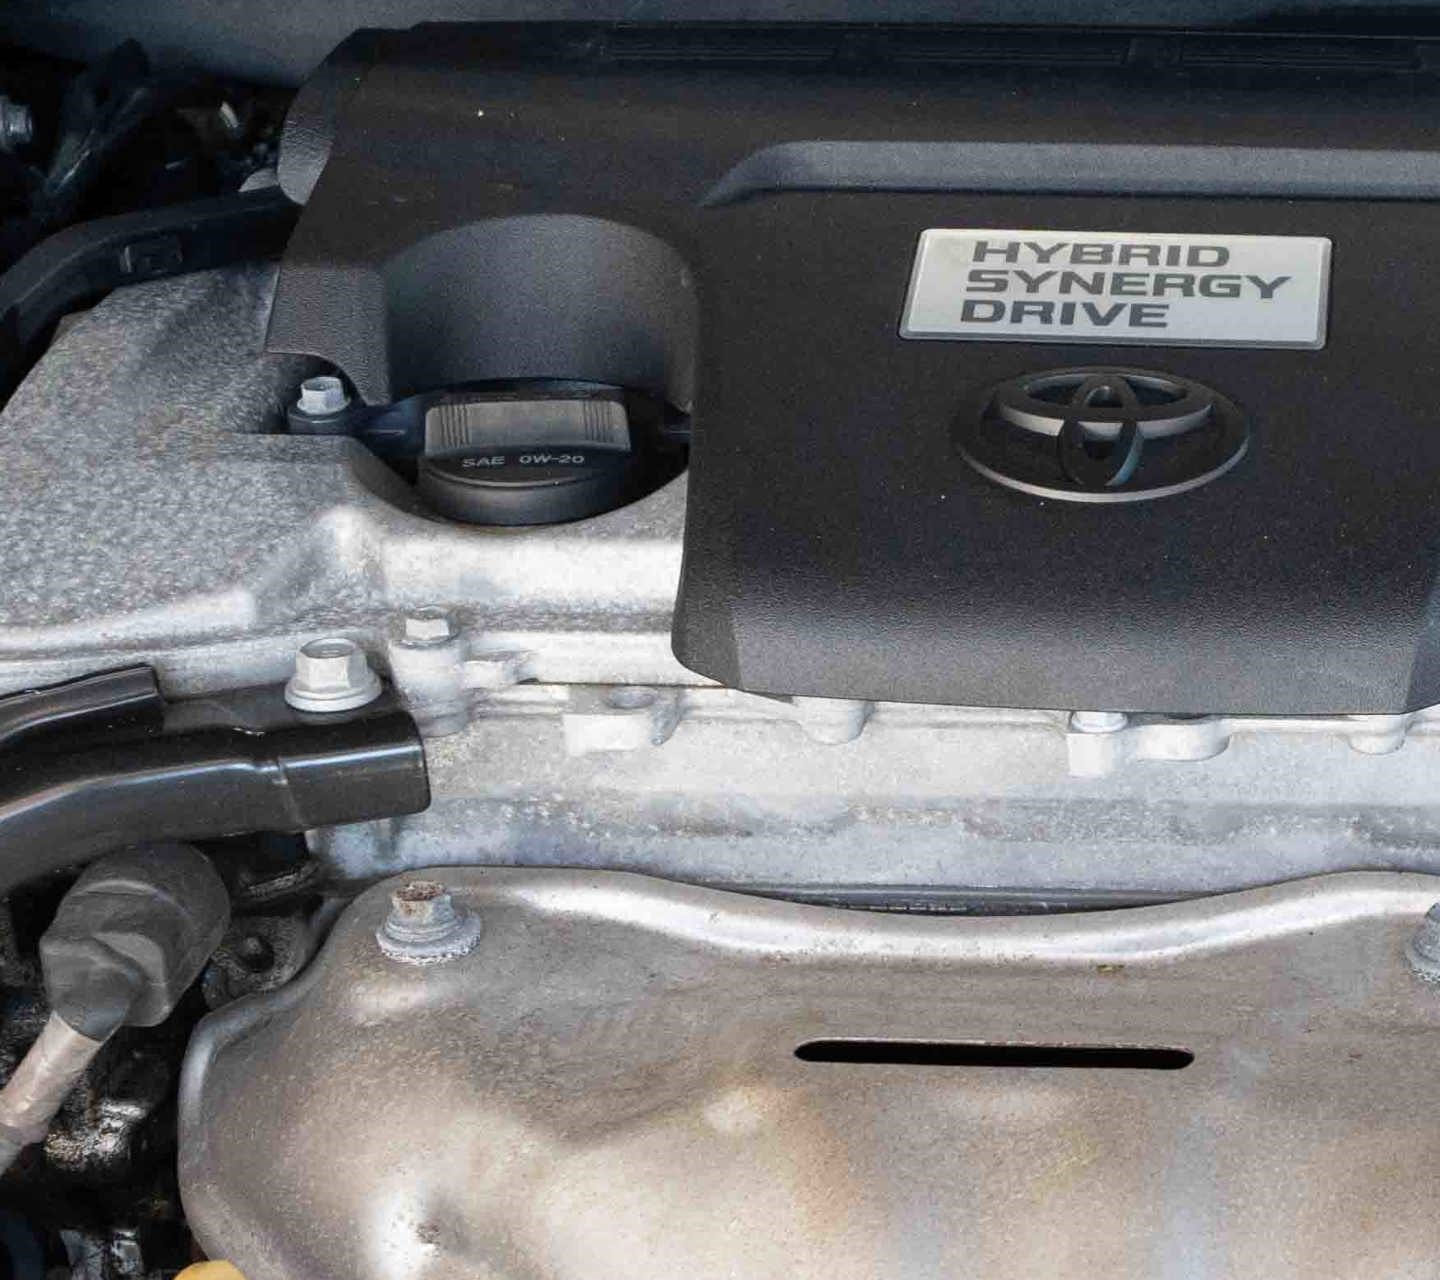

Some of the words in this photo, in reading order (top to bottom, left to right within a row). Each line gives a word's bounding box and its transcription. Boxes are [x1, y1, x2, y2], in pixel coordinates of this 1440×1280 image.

[971, 240, 1231, 268] HYBRID
[965, 270, 1292, 299] SYNERGY
[960, 299, 1170, 328] DRIVE
[462, 455, 505, 468] SAE
[518, 454, 586, 465] 0W-20
